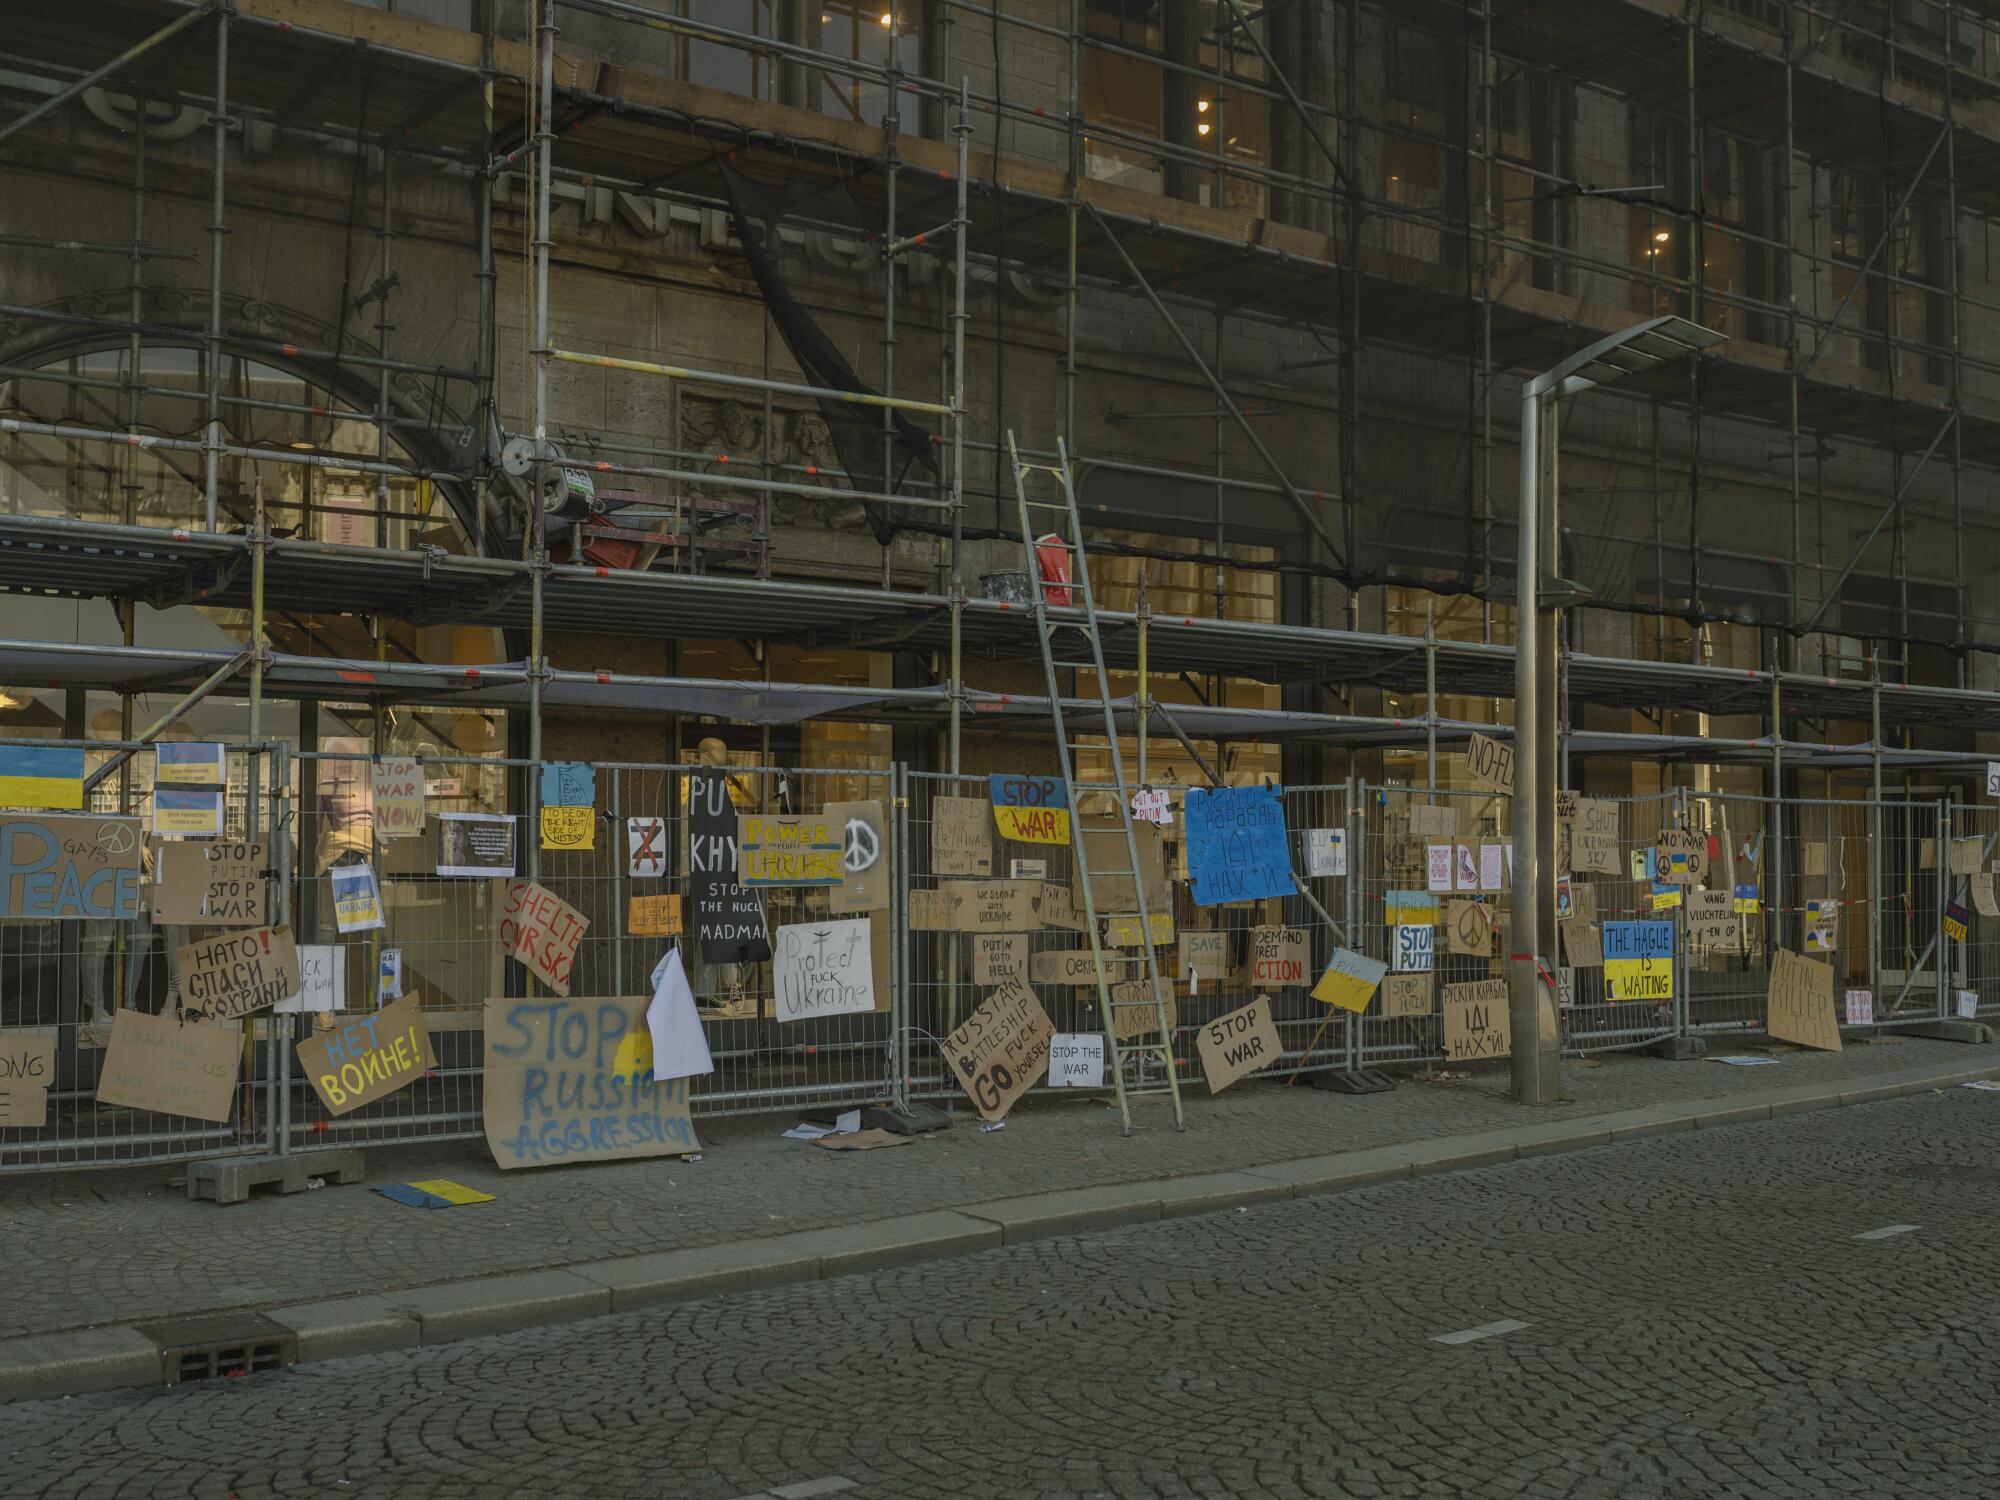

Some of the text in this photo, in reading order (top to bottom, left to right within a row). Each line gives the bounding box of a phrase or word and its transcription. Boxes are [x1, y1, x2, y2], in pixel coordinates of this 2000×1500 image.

[376, 763, 414, 777] STOP
[1467, 736, 1513, 787] NO-FL
[376, 782, 415, 797] WAR
[1003, 780, 1056, 807] STOP
[377, 805, 422, 830] NOW!
[546, 809, 587, 818] TO BE ON
[969, 801, 984, 818] IS
[545, 818, 585, 827] THE RIGHT
[1011, 809, 1057, 840] WAR
[1585, 807, 1617, 832] SHUT
[747, 818, 830, 843] POWER
[1661, 832, 1705, 852] NO WAR
[209, 844, 262, 862] STOP
[1587, 850, 1607, 866] SKY
[211, 864, 259, 879] PUTIN
[208, 879, 256, 898] STOP
[709, 883, 750, 896] STOP
[700, 900, 722, 912] THE
[1704, 893, 1726, 904] VANG
[208, 900, 258, 918] WAR
[1606, 928, 1630, 953] THE
[1633, 927, 1669, 953] HAGUE
[1726, 926, 1735, 937] OP
[195, 929, 270, 970] НАТО!
[983, 940, 1013, 953] PUTIN
[1190, 937, 1222, 951] SAVE
[1641, 952, 1652, 971] IS
[189, 959, 265, 999] СПАСИ
[1623, 975, 1669, 996] WAITING
[945, 977, 1024, 1056] RUSSIAN
[491, 1001, 628, 1069] STOP
[1208, 1008, 1257, 1046] STOP
[324, 1015, 381, 1068] НЕТ
[1005, 1020, 1039, 1060] FUCK
[1052, 1047, 1101, 1059] STOP THE
[1224, 1036, 1265, 1067] WAR
[320, 1025, 422, 1106] ВОЙНЕ!
[1063, 1063, 1090, 1075] WAR
[974, 1063, 1013, 1112] GO
